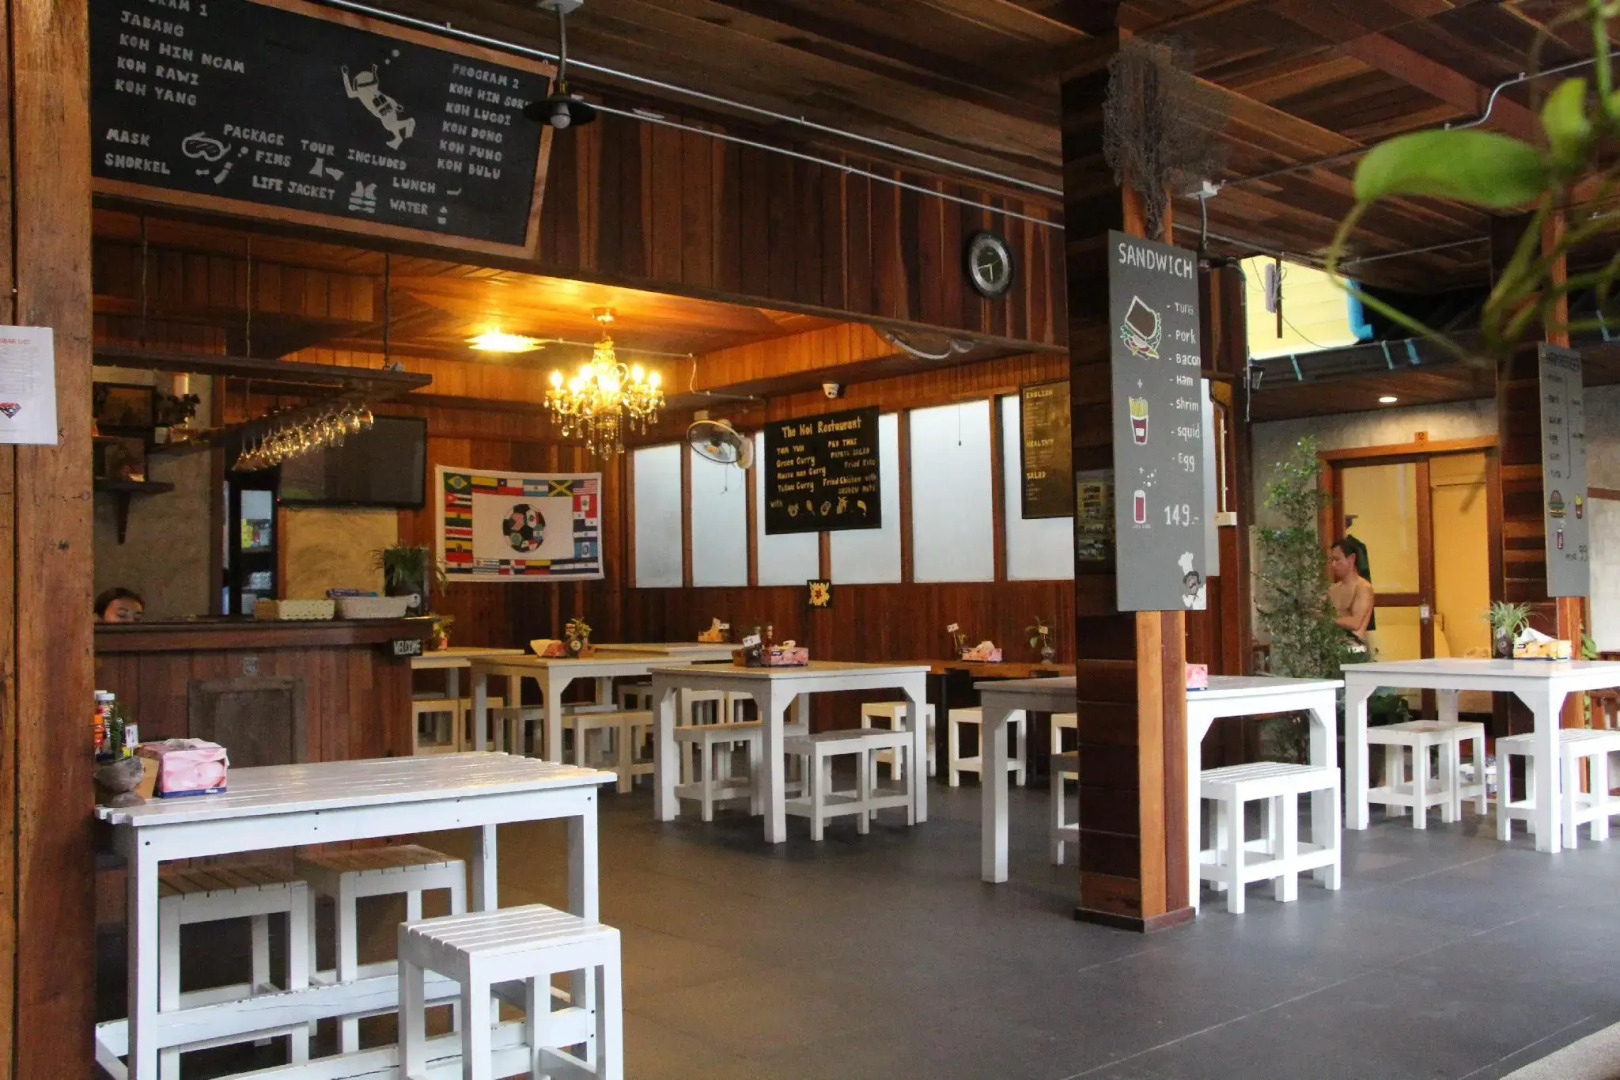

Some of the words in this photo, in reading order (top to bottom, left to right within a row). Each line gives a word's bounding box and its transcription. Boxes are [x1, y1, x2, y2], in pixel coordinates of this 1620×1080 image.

[199, 3, 208, 17] 1
[120, 10, 185, 37] JABANG
[119, 33, 150, 51] KOH
[158, 42, 194, 61] HIN
[201, 53, 245, 74] NGAM
[117, 56, 147, 74] KOH
[155, 65, 199, 86] RAWI
[452, 63, 508, 87] PROGRAM
[512, 78, 519, 89] 2
[115, 79, 147, 96] KOH
[154, 87, 198, 106] YANG
[448, 82, 473, 97] KOH
[477, 89, 501, 105] HIN
[445, 102, 471, 117] KOH
[442, 120, 468, 136] KOH
[106, 128, 151, 147] MASK
[223, 124, 285, 146] PACKAGE
[300, 139, 336, 156] TOUR
[347, 148, 408, 171] INCLUDED
[439, 139, 465, 155] KOH
[104, 152, 171, 175] SNORKEL
[254, 150, 293, 168] FINS
[436, 157, 463, 173] KOH
[252, 174, 284, 192] LIFE
[287, 181, 336, 201] JACKET
[391, 176, 437, 194] LUNCH
[388, 198, 430, 216] WATER
[1118, 242, 1194, 280] SANDWICH
[1175, 328, 1197, 345] Pork
[1175, 353, 1201, 367] Bacon
[1176, 374, 1194, 387] Ham
[781, 425, 796, 438] The
[796, 456, 815, 466] Curry
[1177, 452, 1196, 473] Egg
[808, 466, 826, 476] Curry
[796, 481, 814, 492] Curry
[393, 639, 422, 656] WELCOME
